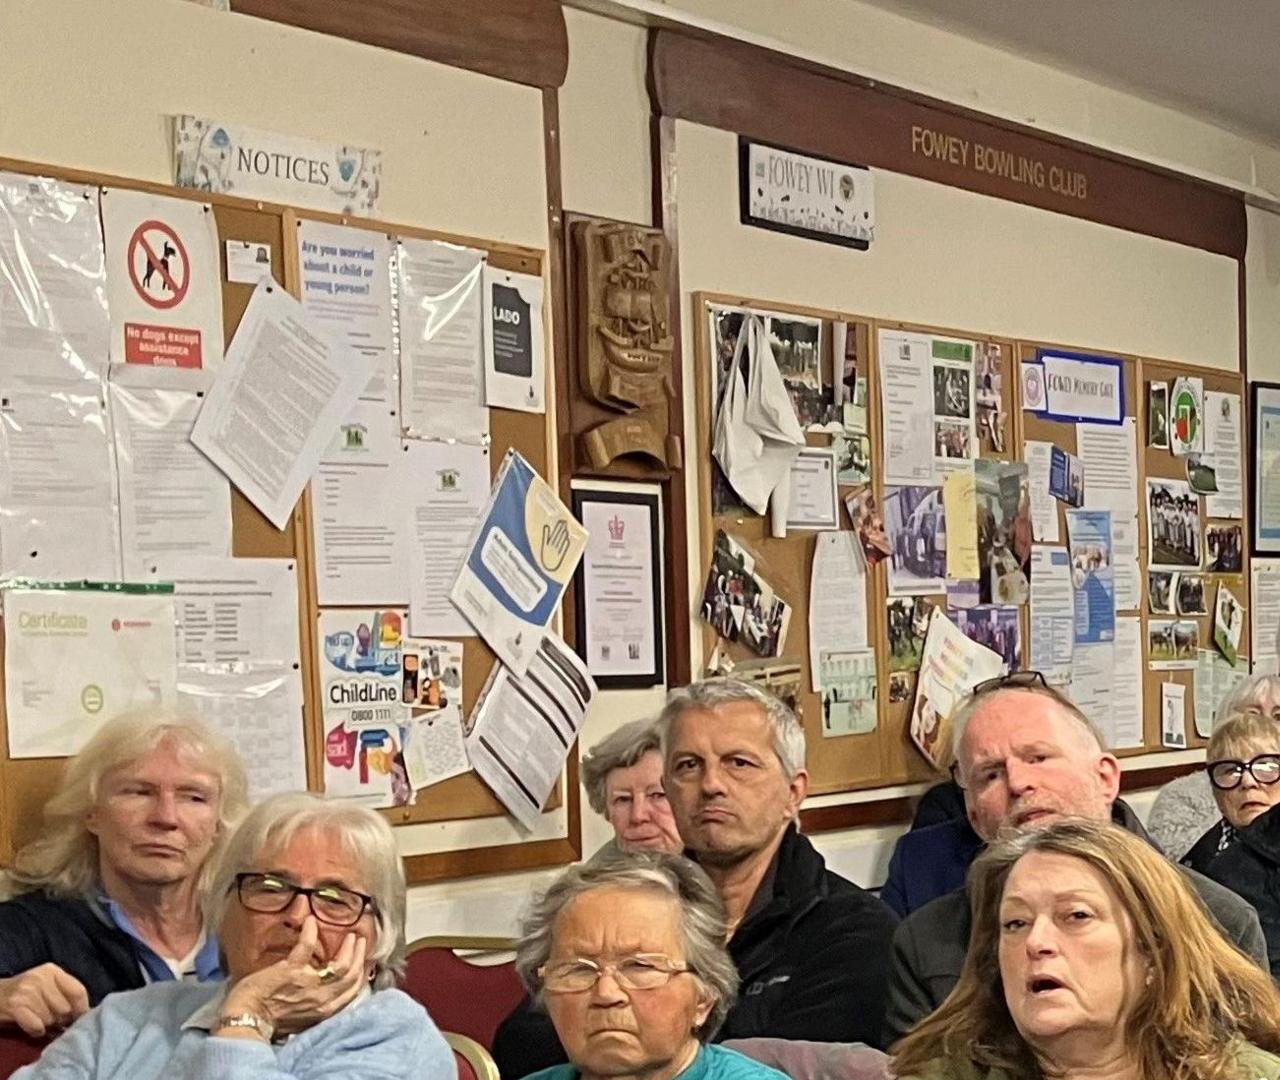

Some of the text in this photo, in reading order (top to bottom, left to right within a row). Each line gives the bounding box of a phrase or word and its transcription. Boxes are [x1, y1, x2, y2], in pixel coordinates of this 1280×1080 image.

[237, 146, 330, 186] NOTICES
[768, 155, 835, 199] FOWEY WI
[912, 126, 1087, 199] FOWEY BOWLING CLUB
[330, 682, 397, 703] ChildLine
